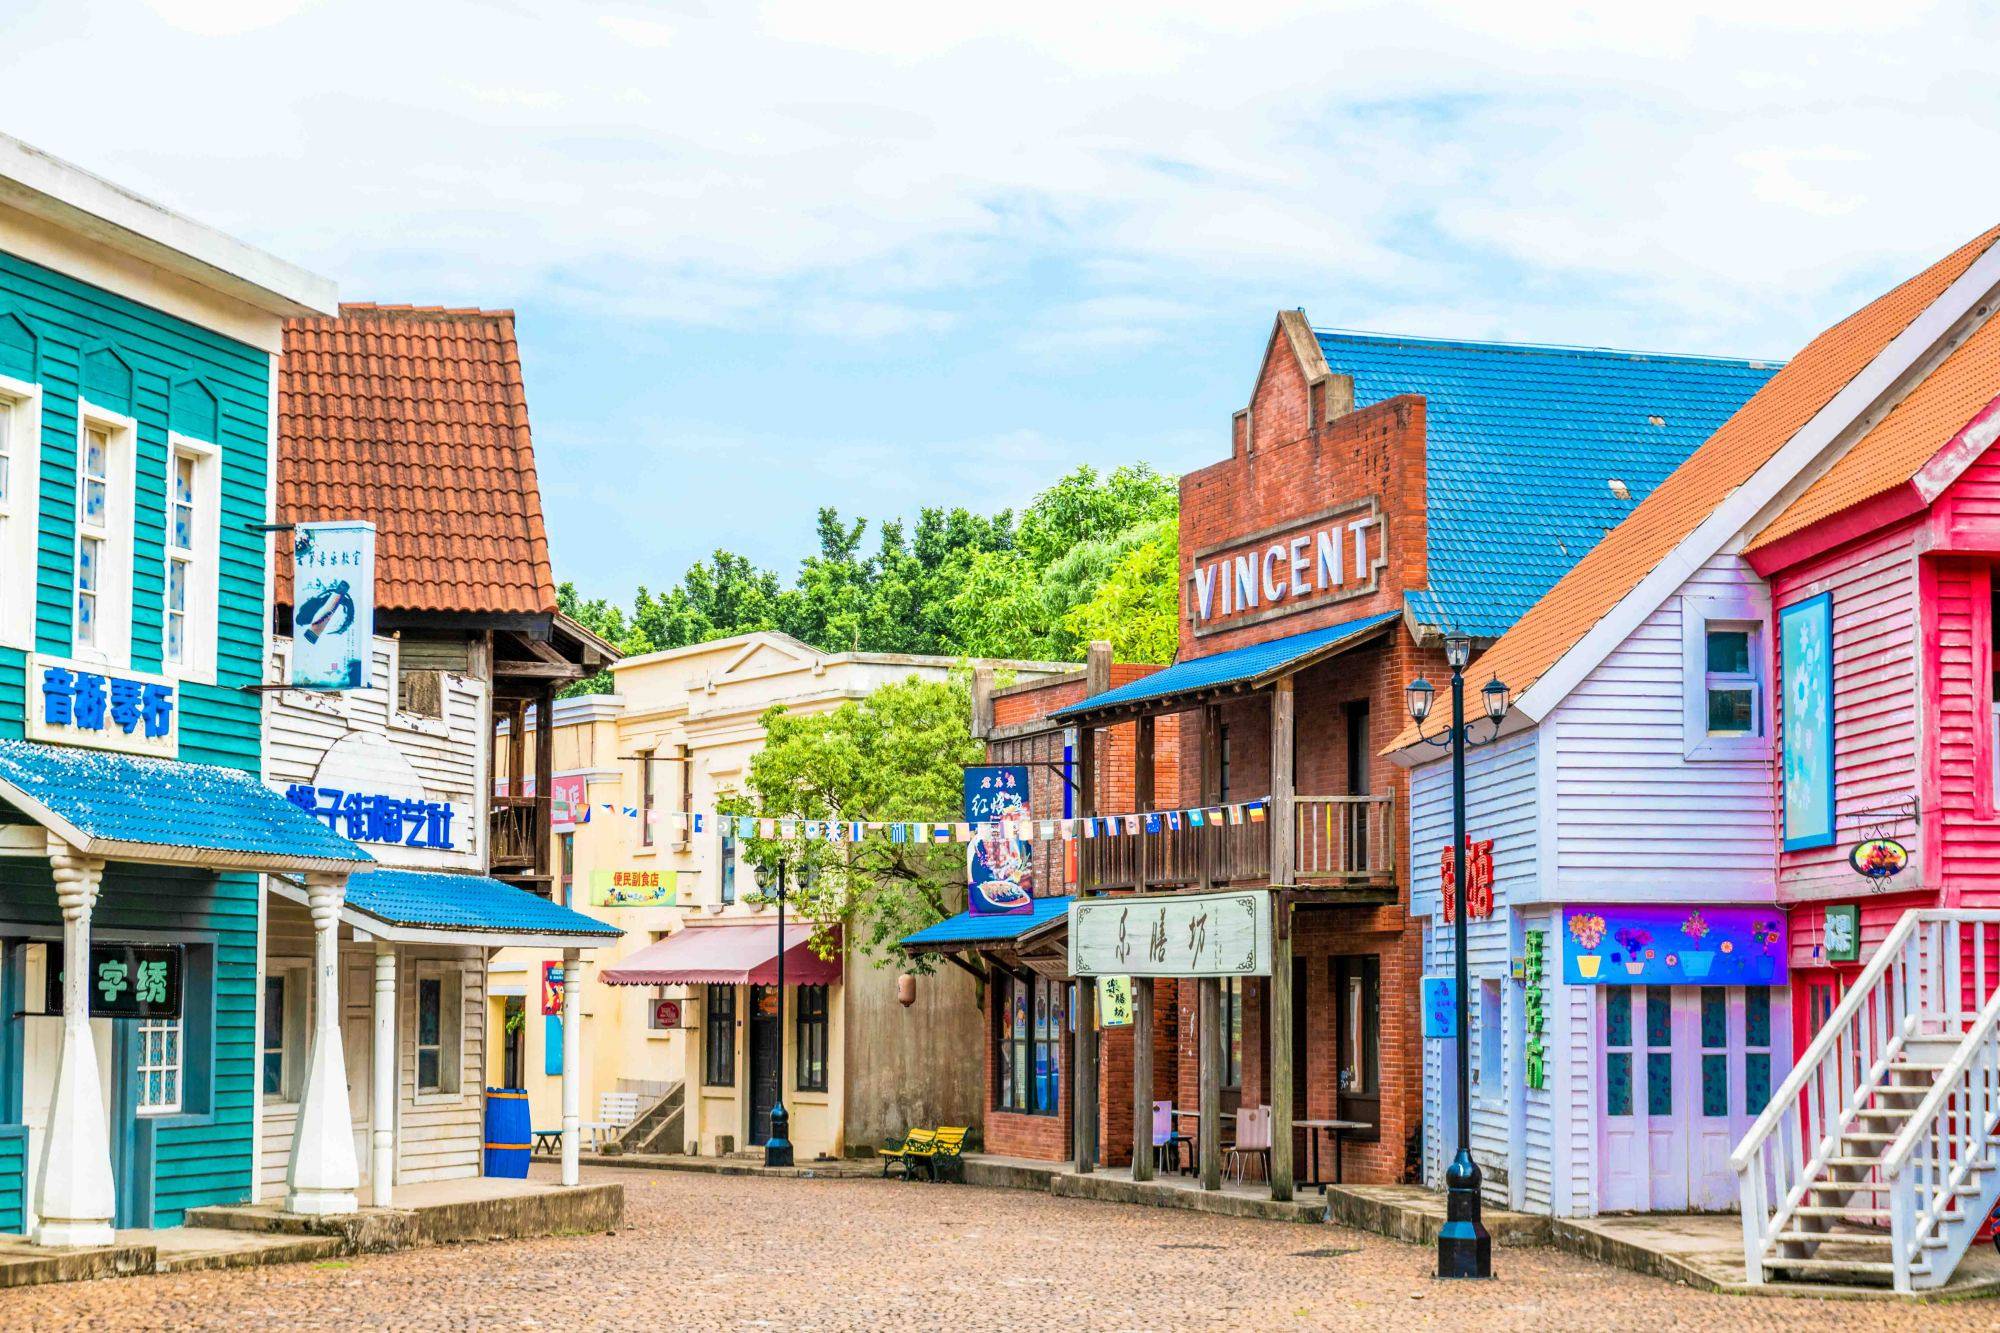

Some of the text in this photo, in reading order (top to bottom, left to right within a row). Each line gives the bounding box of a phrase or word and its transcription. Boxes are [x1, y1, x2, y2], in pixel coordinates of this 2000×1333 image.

[1195, 518, 1373, 619] VINCENT
[614, 872, 659, 886] 便民副食店
[59, 959, 167, 1003] 字绣
